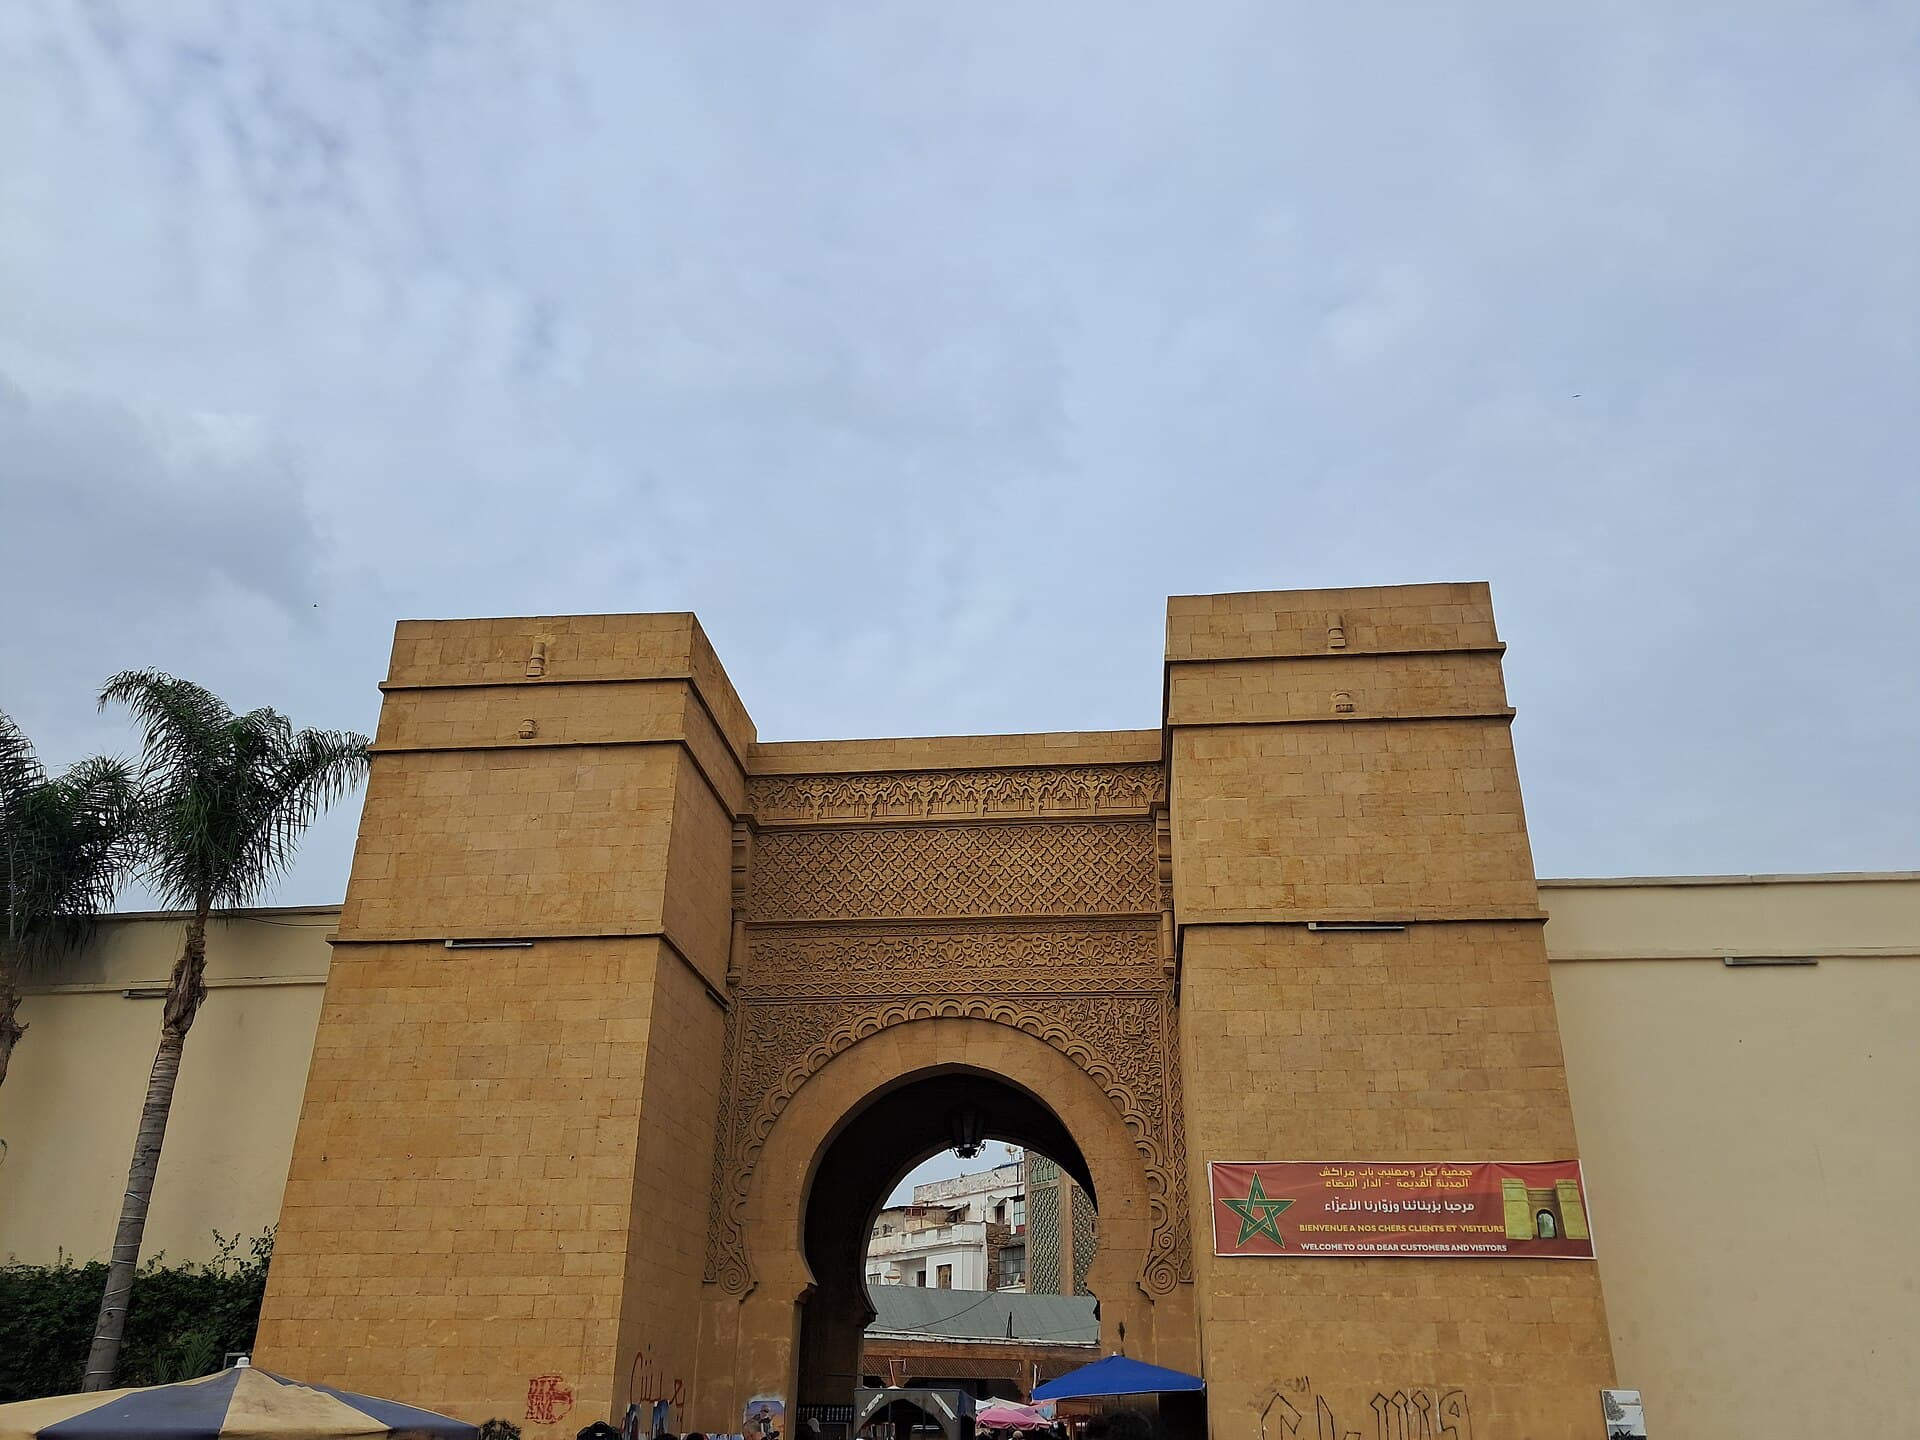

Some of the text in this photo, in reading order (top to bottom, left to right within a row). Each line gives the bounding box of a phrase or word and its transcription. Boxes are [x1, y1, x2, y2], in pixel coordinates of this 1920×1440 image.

[1320, 1166, 1355, 1178] مراكش
[1360, 1168, 1374, 1178] باب
[1420, 1167, 1438, 1178] تجار
[1441, 1167, 1473, 1178] جمعية
[1326, 1178, 1358, 1189] البيضاء
[1362, 1178, 1382, 1189] الدار
[1396, 1176, 1432, 1189] القديمة
[1436, 1178, 1468, 1189] المدينة
[1444, 1200, 1474, 1213] مرحبا
